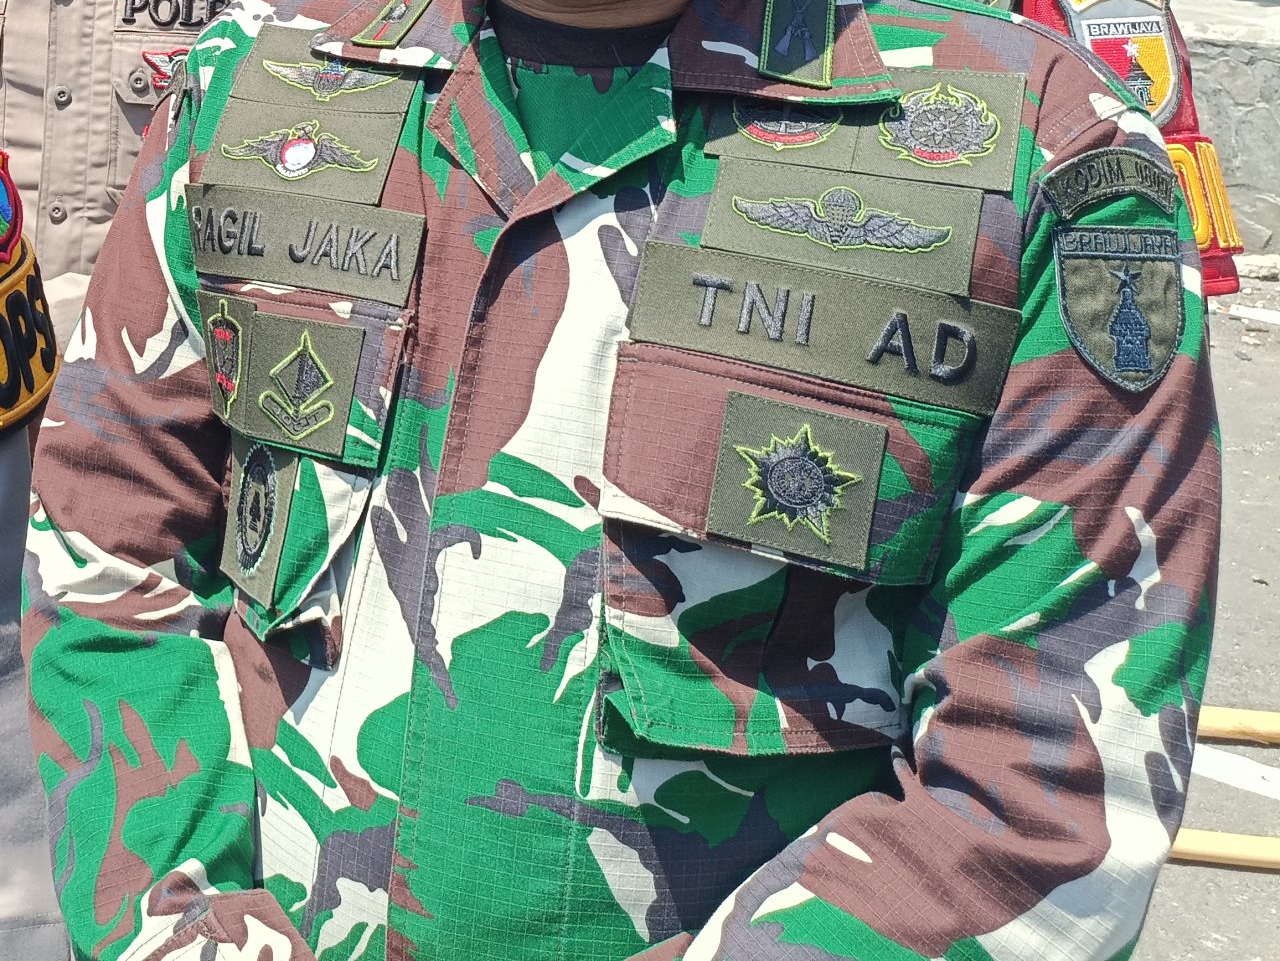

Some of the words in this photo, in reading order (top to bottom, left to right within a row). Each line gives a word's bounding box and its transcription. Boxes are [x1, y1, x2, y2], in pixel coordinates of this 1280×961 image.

[1090, 21, 1161, 36] BRAWIJAYA
[1059, 156, 1126, 202] KODIM
[288, 220, 401, 280] JAKA
[692, 272, 816, 346] TNI
[866, 309, 978, 383] AD
